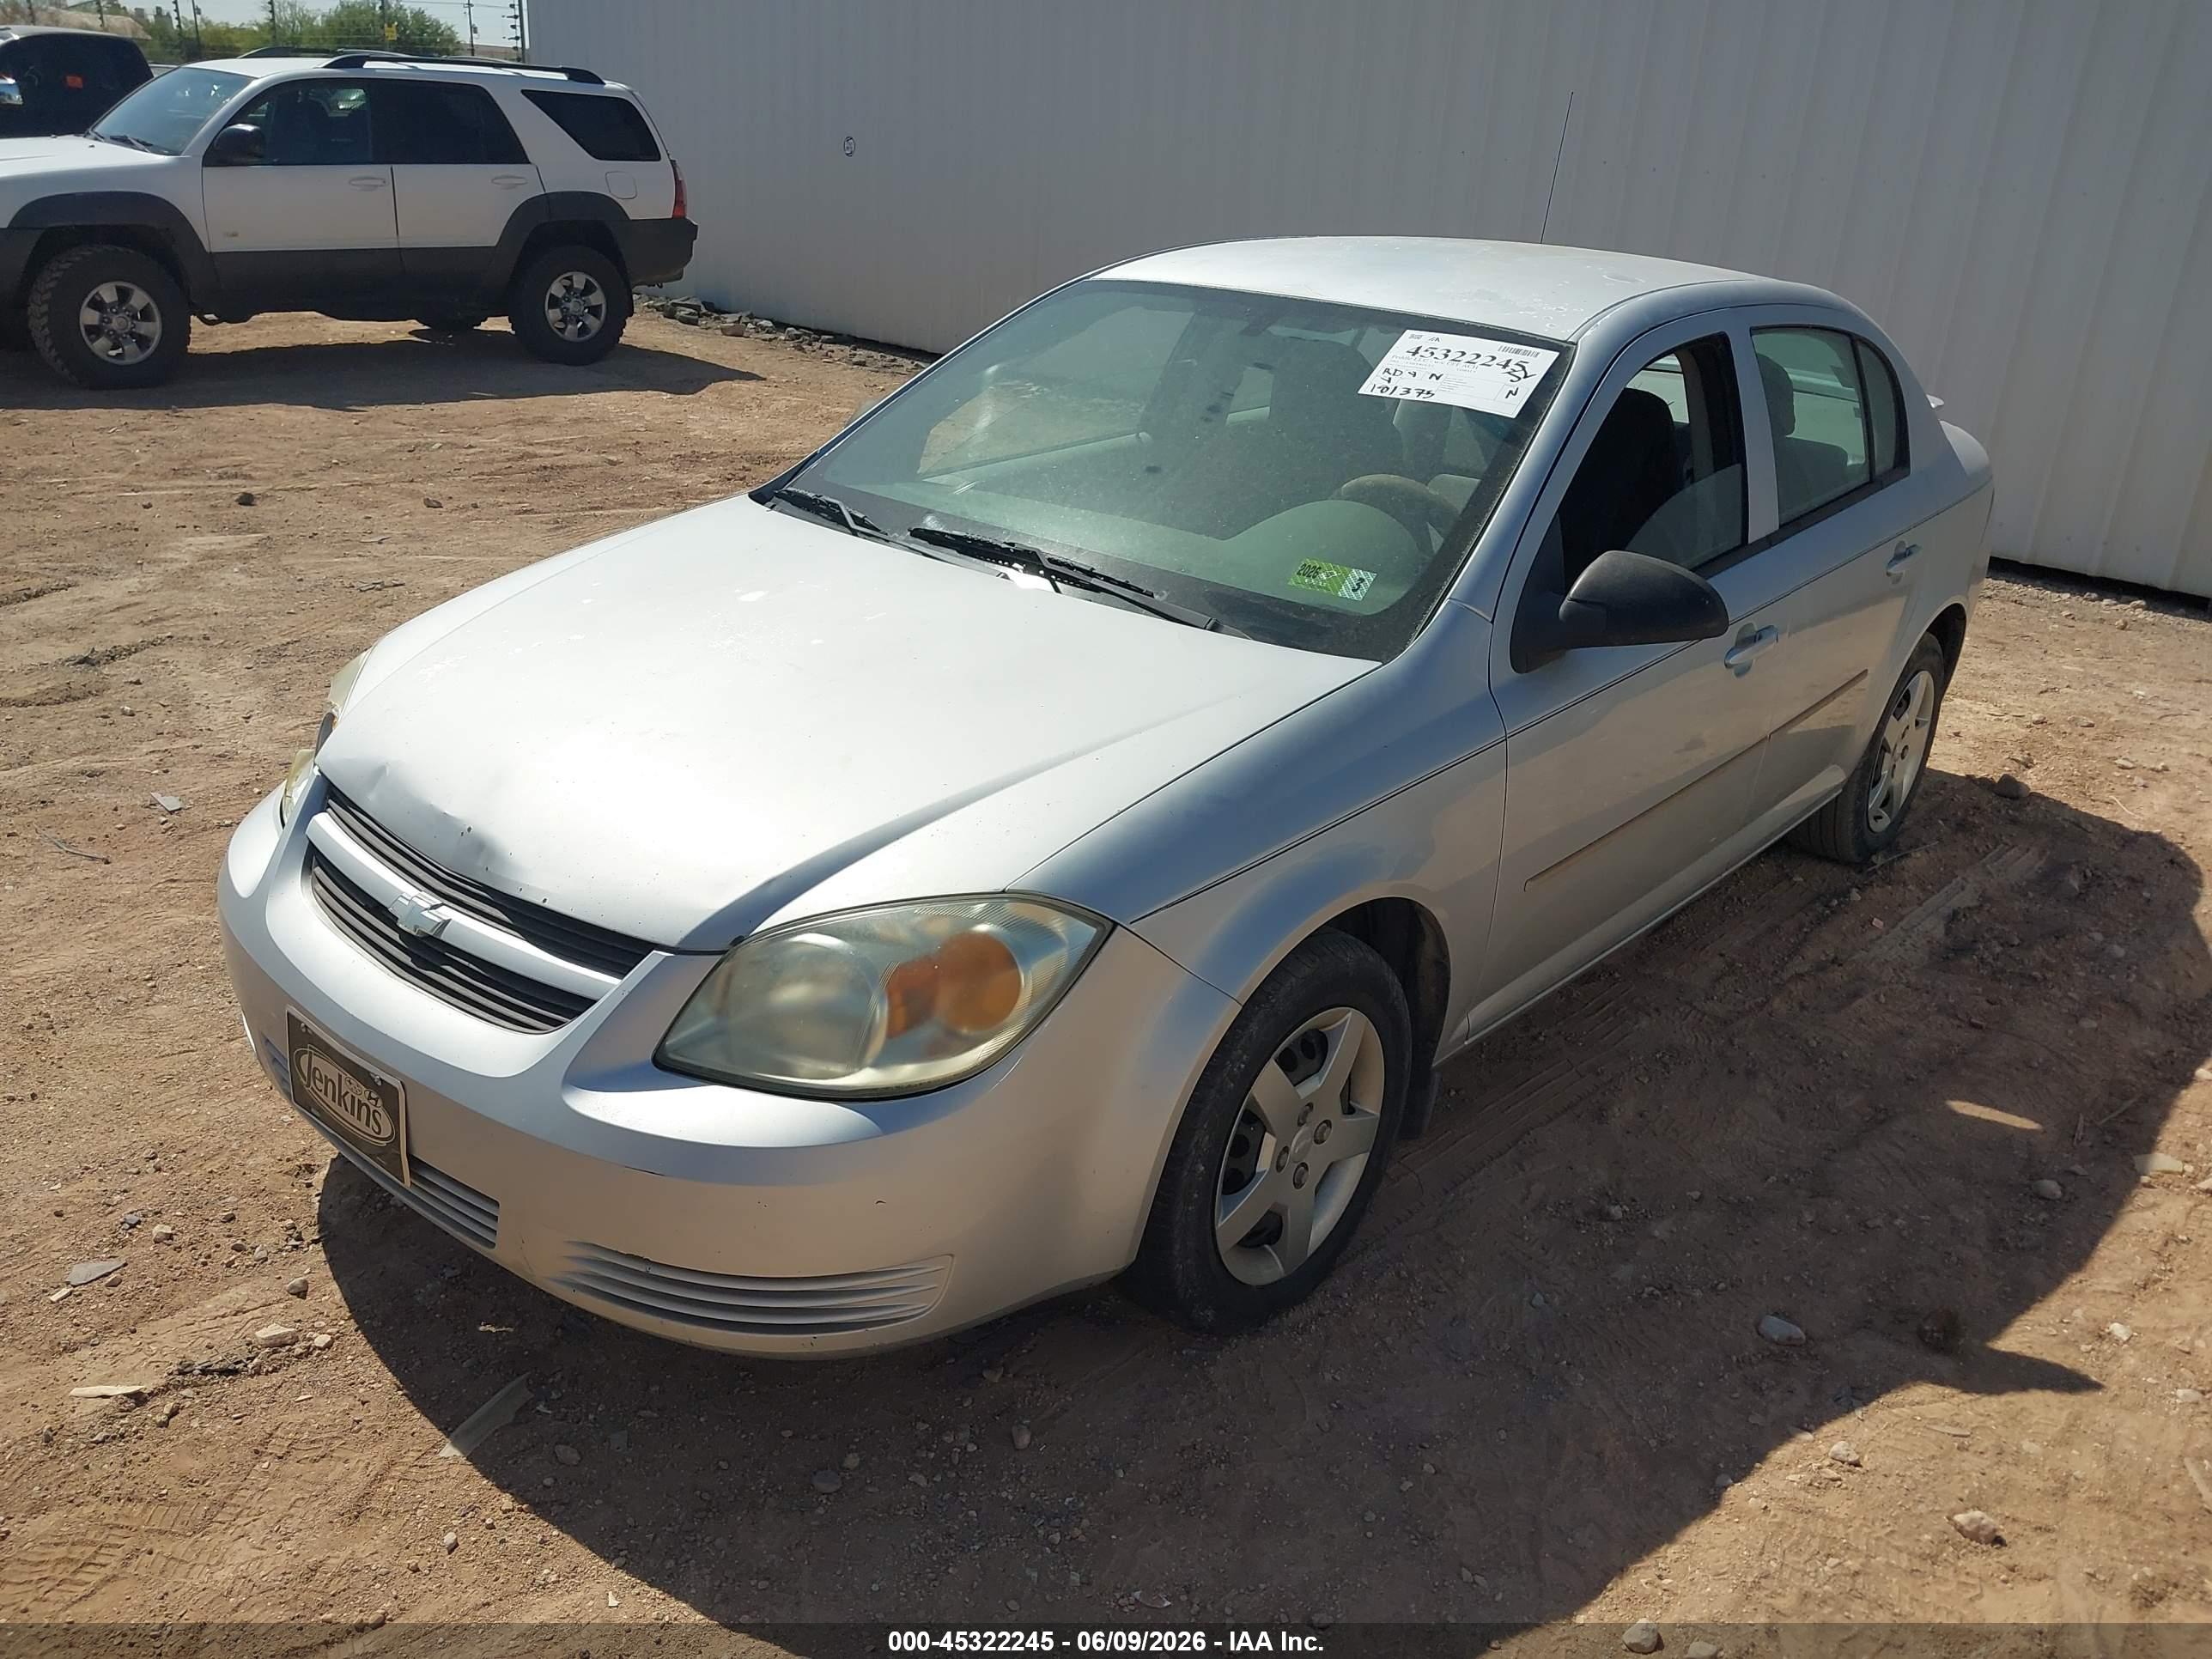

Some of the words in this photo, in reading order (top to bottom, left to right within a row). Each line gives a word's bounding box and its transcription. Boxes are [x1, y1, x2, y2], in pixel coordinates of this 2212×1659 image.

[1406, 345, 1530, 374] 45322245
[1297, 563, 1322, 579] 2026
[1351, 577, 1365, 592] 3
[306, 1047, 383, 1136] Jenkins
